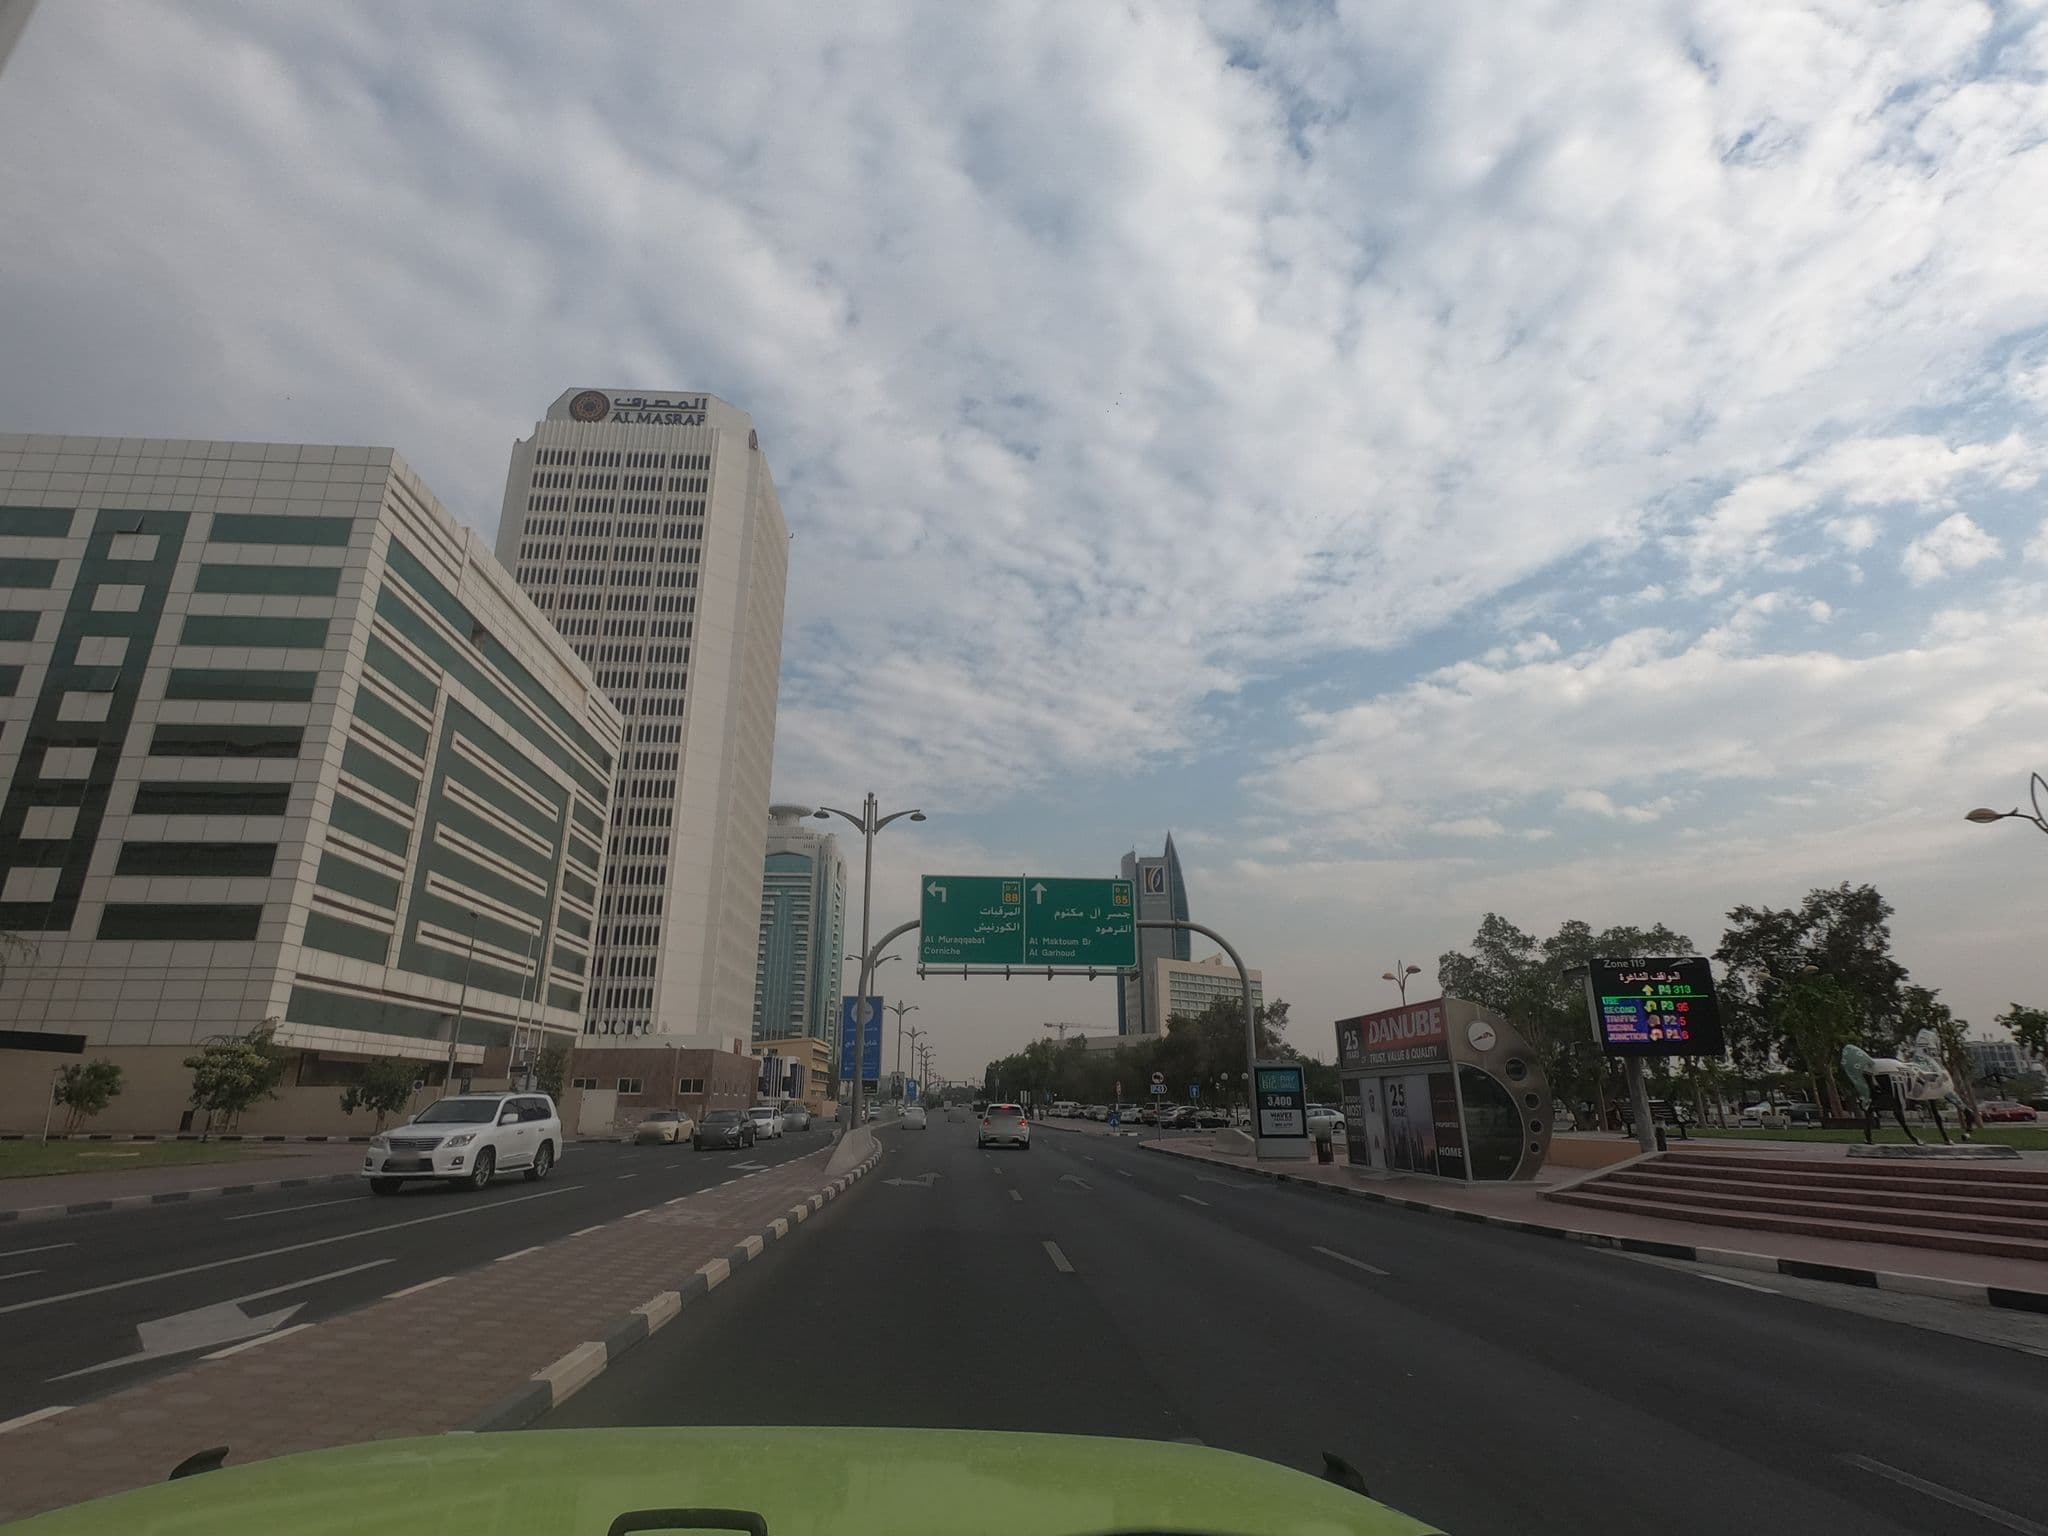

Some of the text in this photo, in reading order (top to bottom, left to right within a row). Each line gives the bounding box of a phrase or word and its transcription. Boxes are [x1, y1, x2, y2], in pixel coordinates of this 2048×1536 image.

[614, 398, 707, 410] المصرف
[611, 411, 705, 425] AL MASRAF
[980, 906, 1020, 918] المرقبات
[1054, 907, 1084, 920] مكتوم
[1106, 911, 1131, 920] جسر
[973, 923, 1020, 933] الكورنيش
[1096, 924, 1131, 935] القرهود
[924, 947, 961, 955] Corniche
[1042, 949, 1076, 957] Garhoud
[1604, 959, 1646, 968] Zone 119
[1619, 971, 1681, 984] المواقف الشاغرة
[1658, 984, 1691, 995] P4 313
[1604, 1006, 1637, 1014] SECOND
[1661, 1000, 1674, 1011] P3
[1604, 1015, 1637, 1023] TRAFFIC
[1663, 1015, 1686, 1025] P2 5
[1368, 1007, 1441, 1044] DANUBE
[1608, 1033, 1648, 1041] JUNCTION
[1666, 1029, 1681, 1039] P1
[1344, 1030, 1359, 1051] 25
[1387, 1050, 1405, 1061] VALUE
[1411, 1045, 1438, 1059] QUALITY
[1389, 1083, 1405, 1107] 25
[1267, 1096, 1292, 1107] 3,400
[1439, 1146, 1463, 1158] HOME
